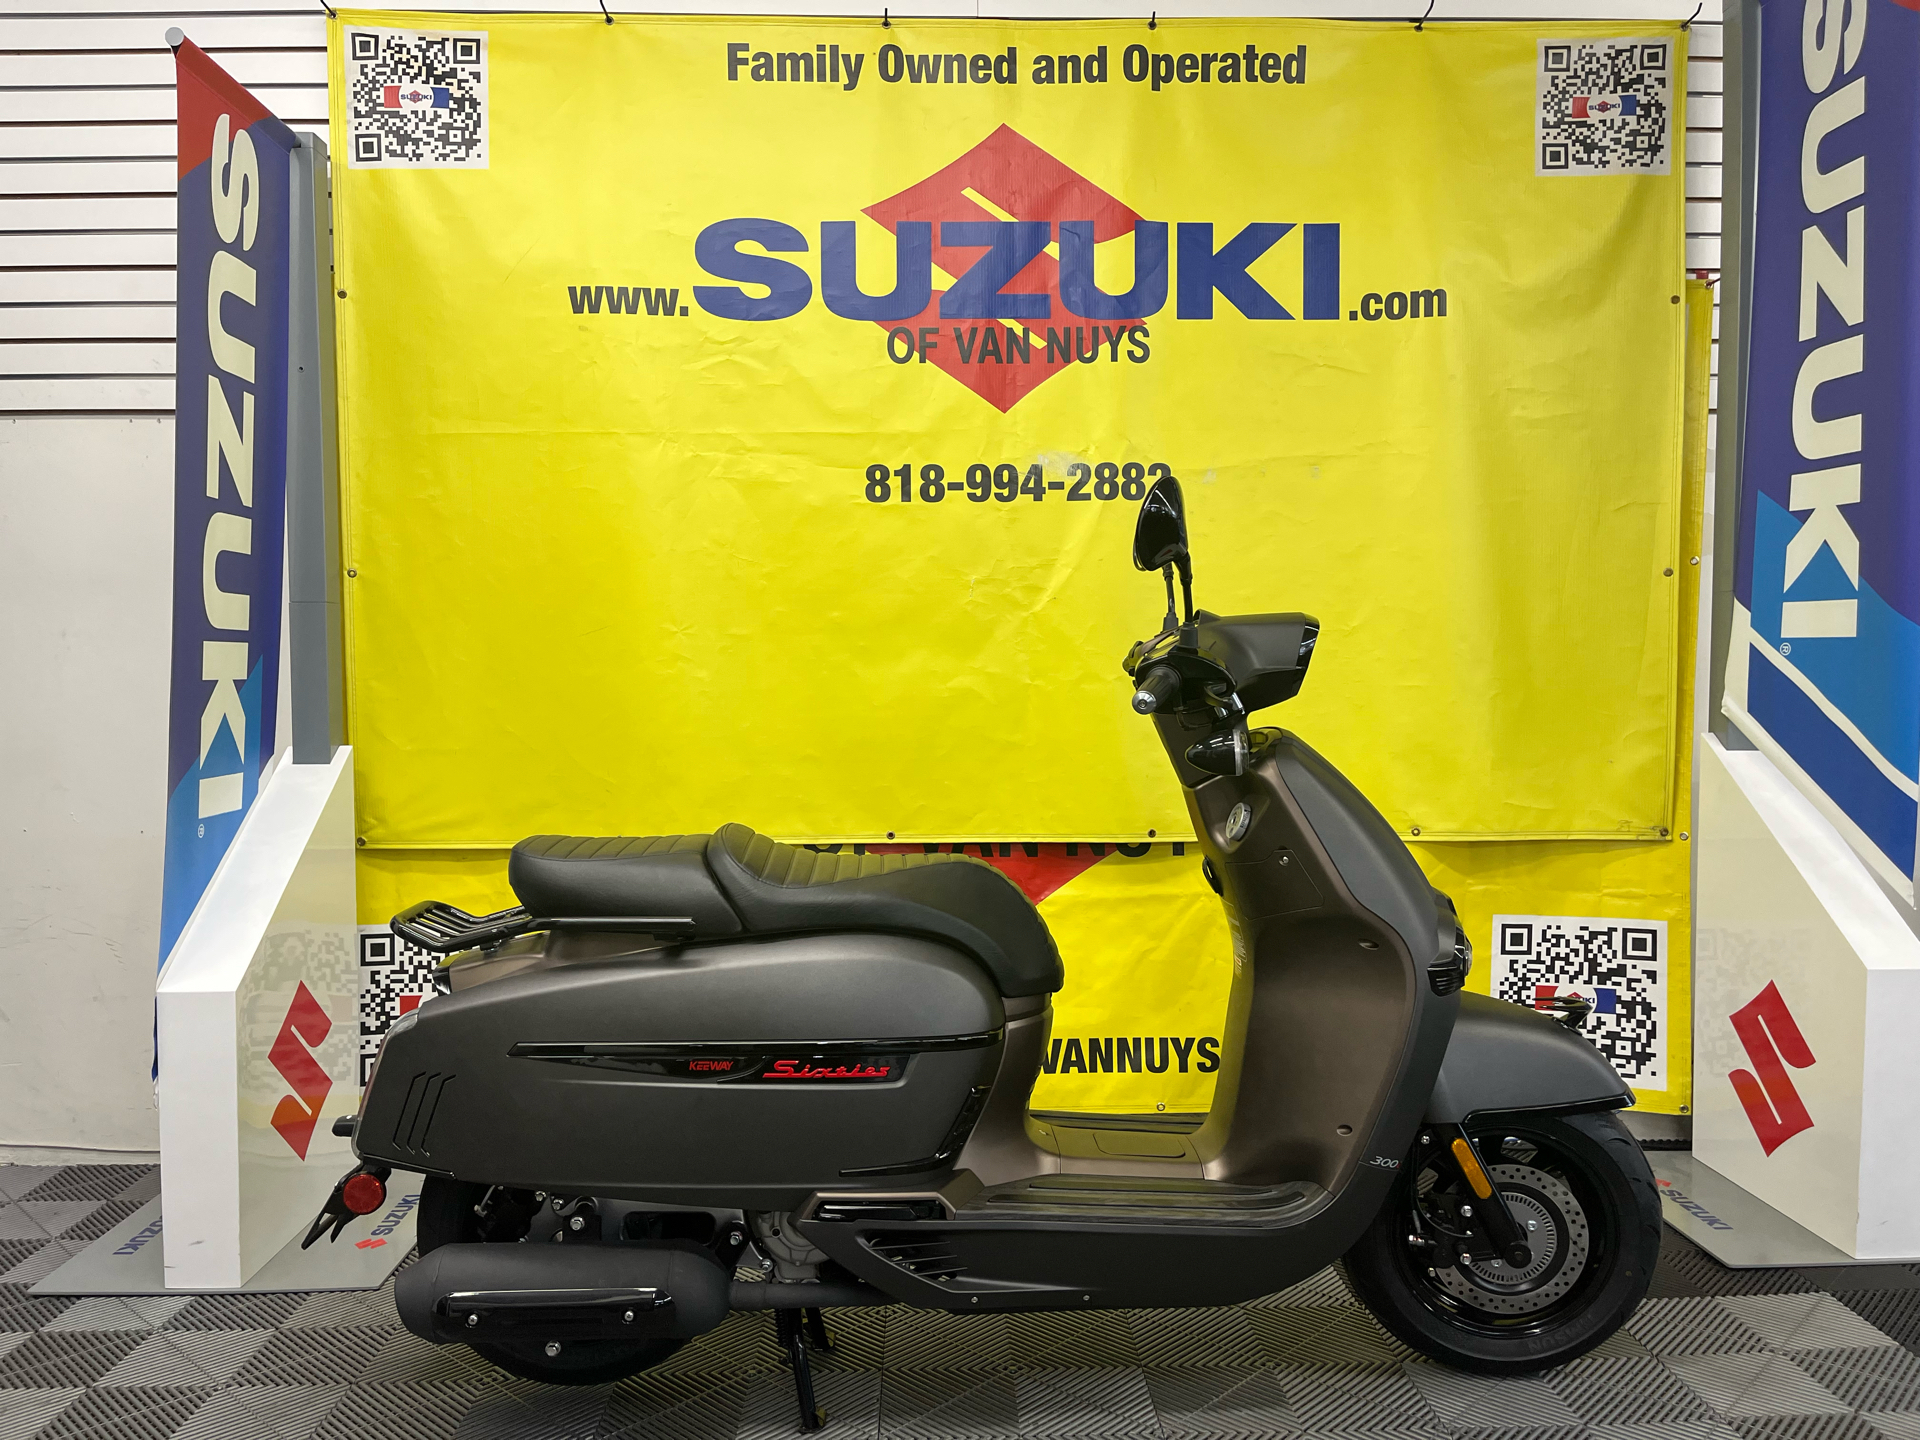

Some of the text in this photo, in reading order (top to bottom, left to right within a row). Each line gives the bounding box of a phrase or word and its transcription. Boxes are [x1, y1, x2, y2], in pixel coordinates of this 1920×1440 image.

[727, 42, 1307, 92] Family Owned and Operated
[887, 325, 1150, 364] OF VAN NUYS
[198, 113, 260, 819] SUZUKI
[688, 1060, 891, 1079] KEEWAY Sixties
[370, 1194, 420, 1236] SUZUKI
[1659, 1189, 1734, 1230] SUZUKI
[112, 1215, 163, 1256] UZUKI
